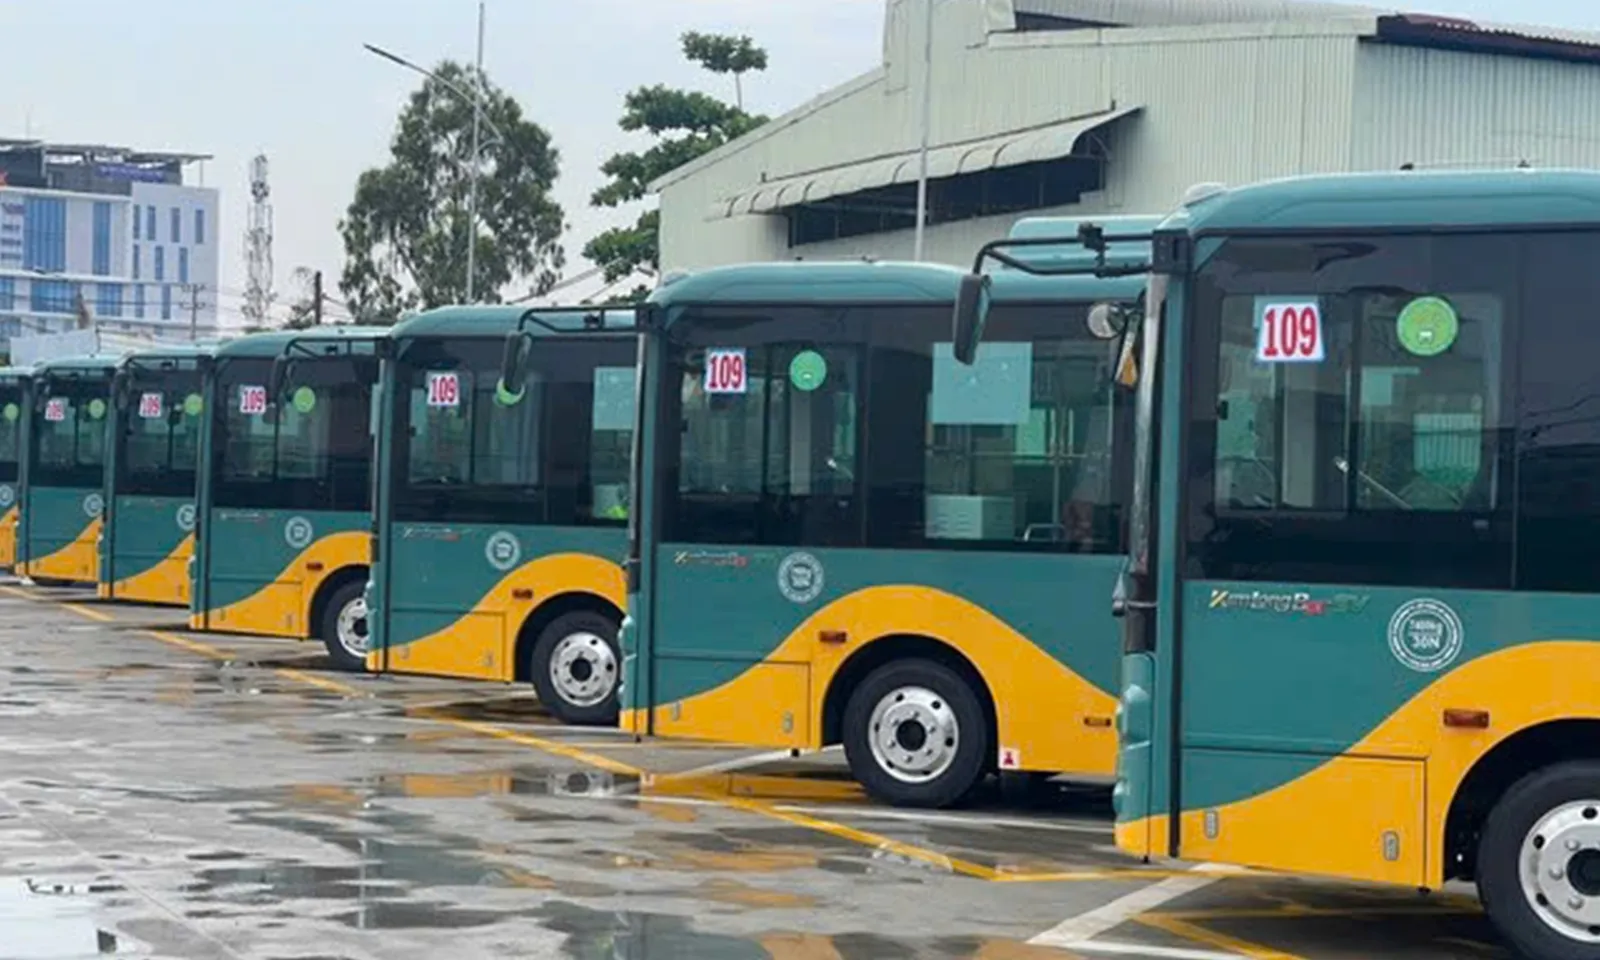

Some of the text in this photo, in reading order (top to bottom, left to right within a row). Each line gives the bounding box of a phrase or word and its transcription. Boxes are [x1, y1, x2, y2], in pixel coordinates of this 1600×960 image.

[1264, 307, 1317, 357] 109
[431, 376, 457, 402] 109
[709, 355, 743, 389] 109
